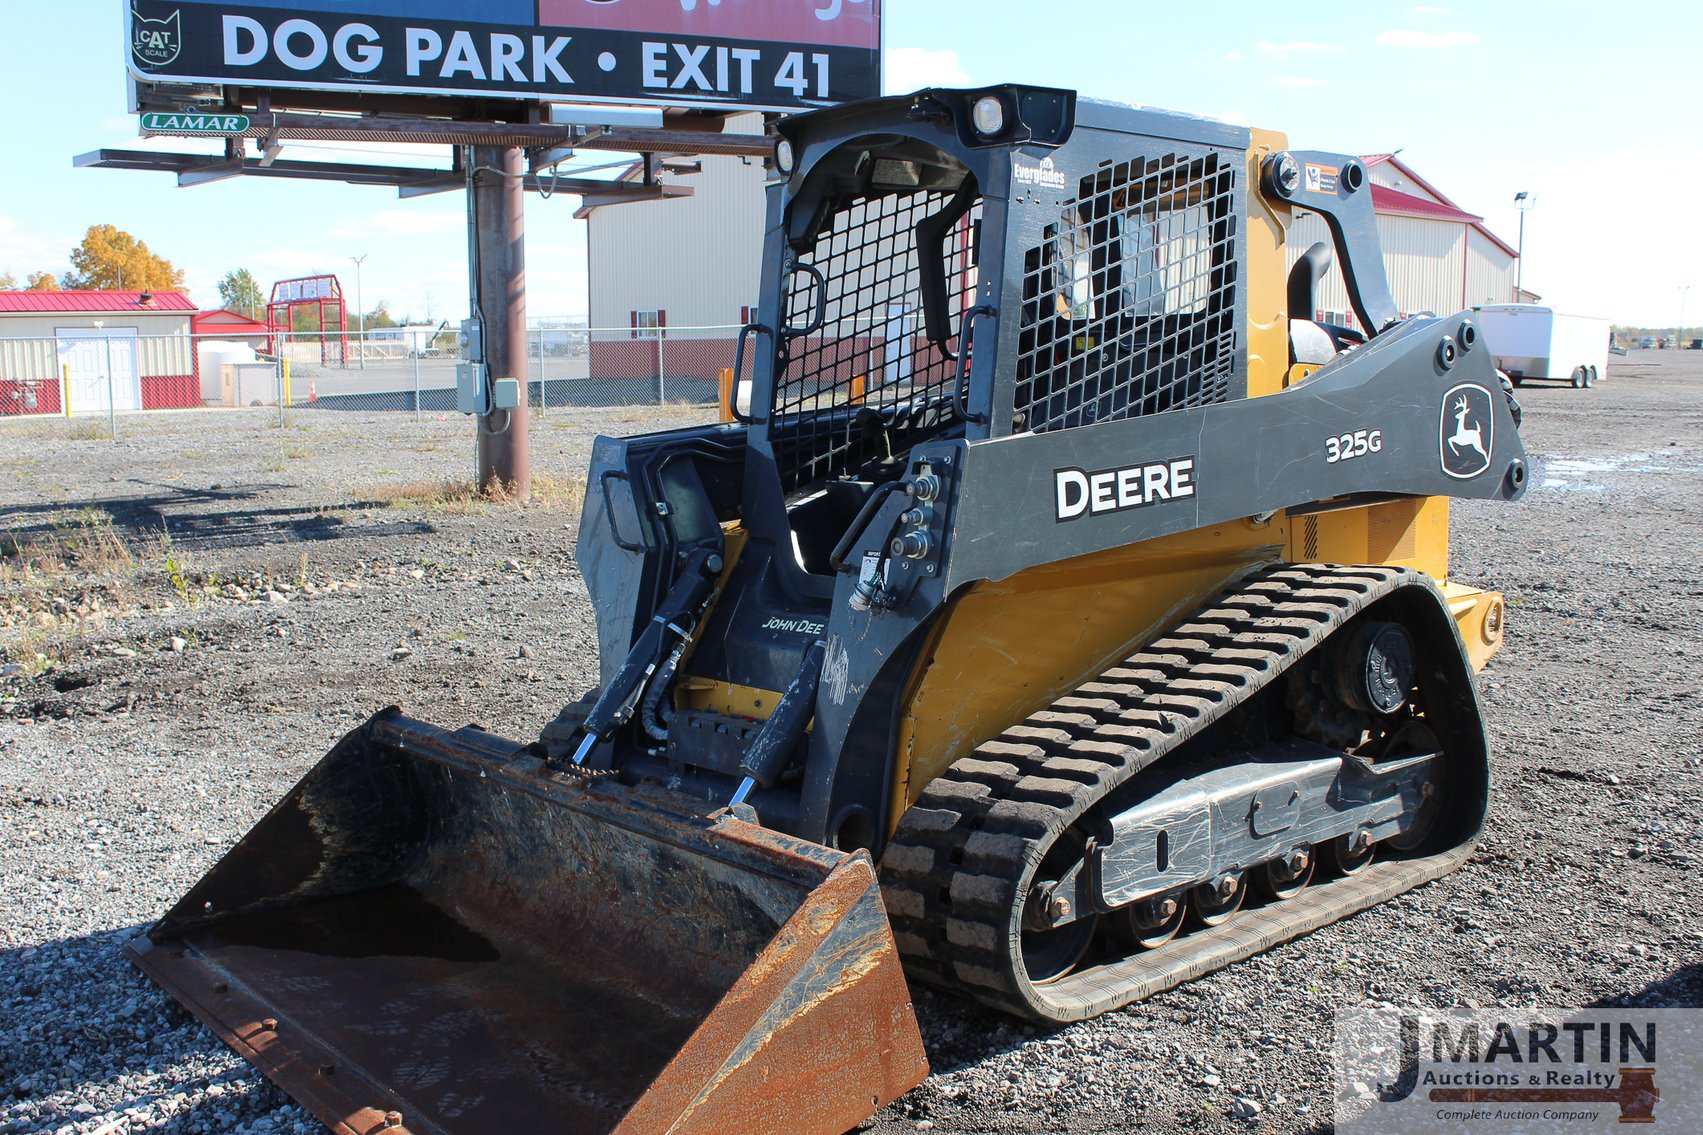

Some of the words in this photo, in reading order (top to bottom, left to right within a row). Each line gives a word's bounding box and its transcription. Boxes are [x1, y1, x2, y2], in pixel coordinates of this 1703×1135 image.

[140, 30, 171, 49] CAT
[145, 49, 169, 58] SCALE
[222, 14, 384, 73] DOG
[405, 27, 575, 84] PARK
[641, 41, 761, 94] EXIT
[774, 51, 830, 98] 41
[150, 115, 239, 130] LAMAR
[1014, 163, 1065, 186] Everglades
[1326, 430, 1382, 463] 325G
[1056, 459, 1195, 519] DEERE
[761, 617, 797, 632] JOHN
[795, 620, 825, 635] DEE
